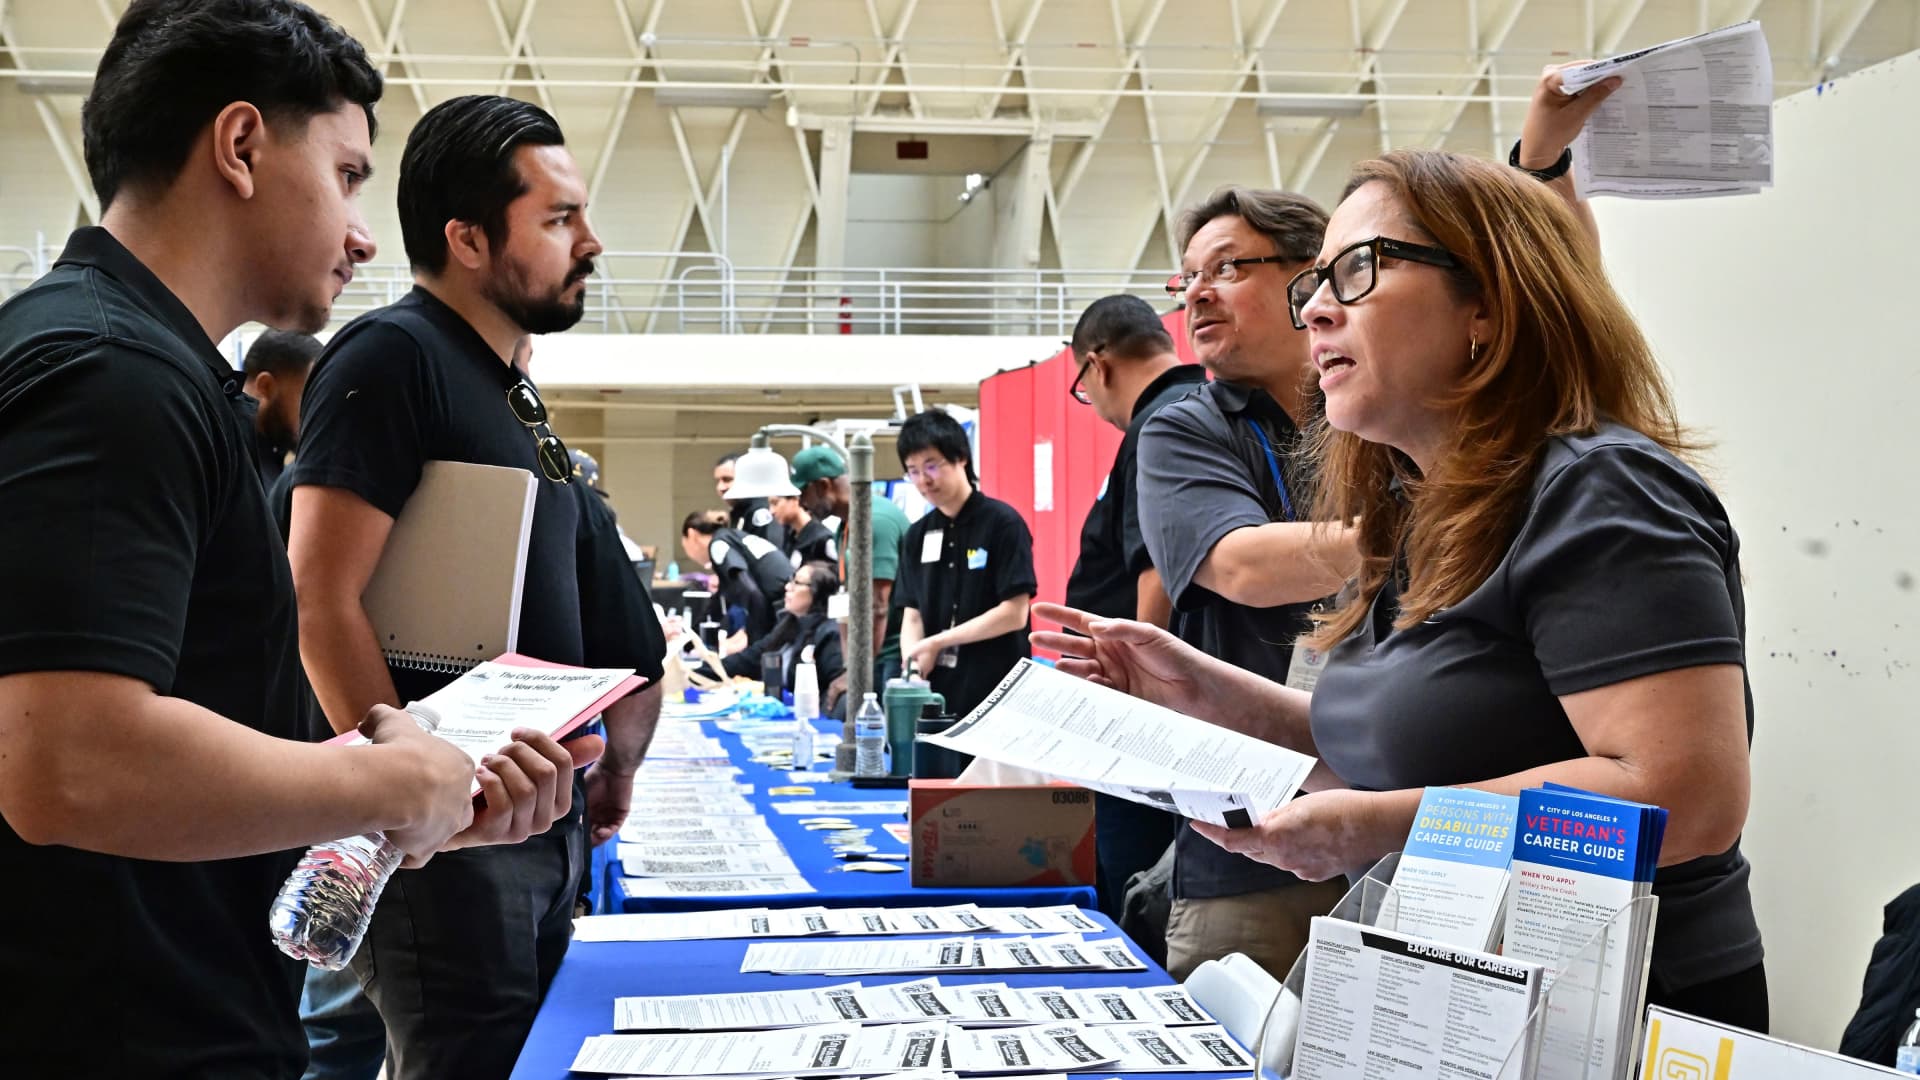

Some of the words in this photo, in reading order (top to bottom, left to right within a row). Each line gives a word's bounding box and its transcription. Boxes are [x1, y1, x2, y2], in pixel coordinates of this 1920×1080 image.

[1052, 792, 1090, 804] 03086
[1425, 804, 1480, 821] PERSONS
[1483, 811, 1514, 824] WITH
[1572, 810, 1583, 818] LOS
[1584, 813, 1611, 822] ANGELES
[1420, 817, 1510, 839] DISABILITIES
[1526, 814, 1626, 845] VETERAN'S
[1415, 832, 1461, 847] CAREER
[1465, 838, 1504, 852] GUIDE
[1523, 833, 1579, 853] CAREER
[1584, 843, 1625, 861] GUIDE
[1520, 881, 1540, 890] Military
[1541, 884, 1559, 893] Service
[1560, 888, 1578, 896] Credits
[1521, 871, 1541, 879] WHEN
[1542, 874, 1555, 882] YOU
[1556, 877, 1576, 886] APPLY
[1407, 942, 1452, 961] EXPLORE
[1455, 953, 1476, 968] OUR
[1478, 960, 1525, 979] CAREERS
